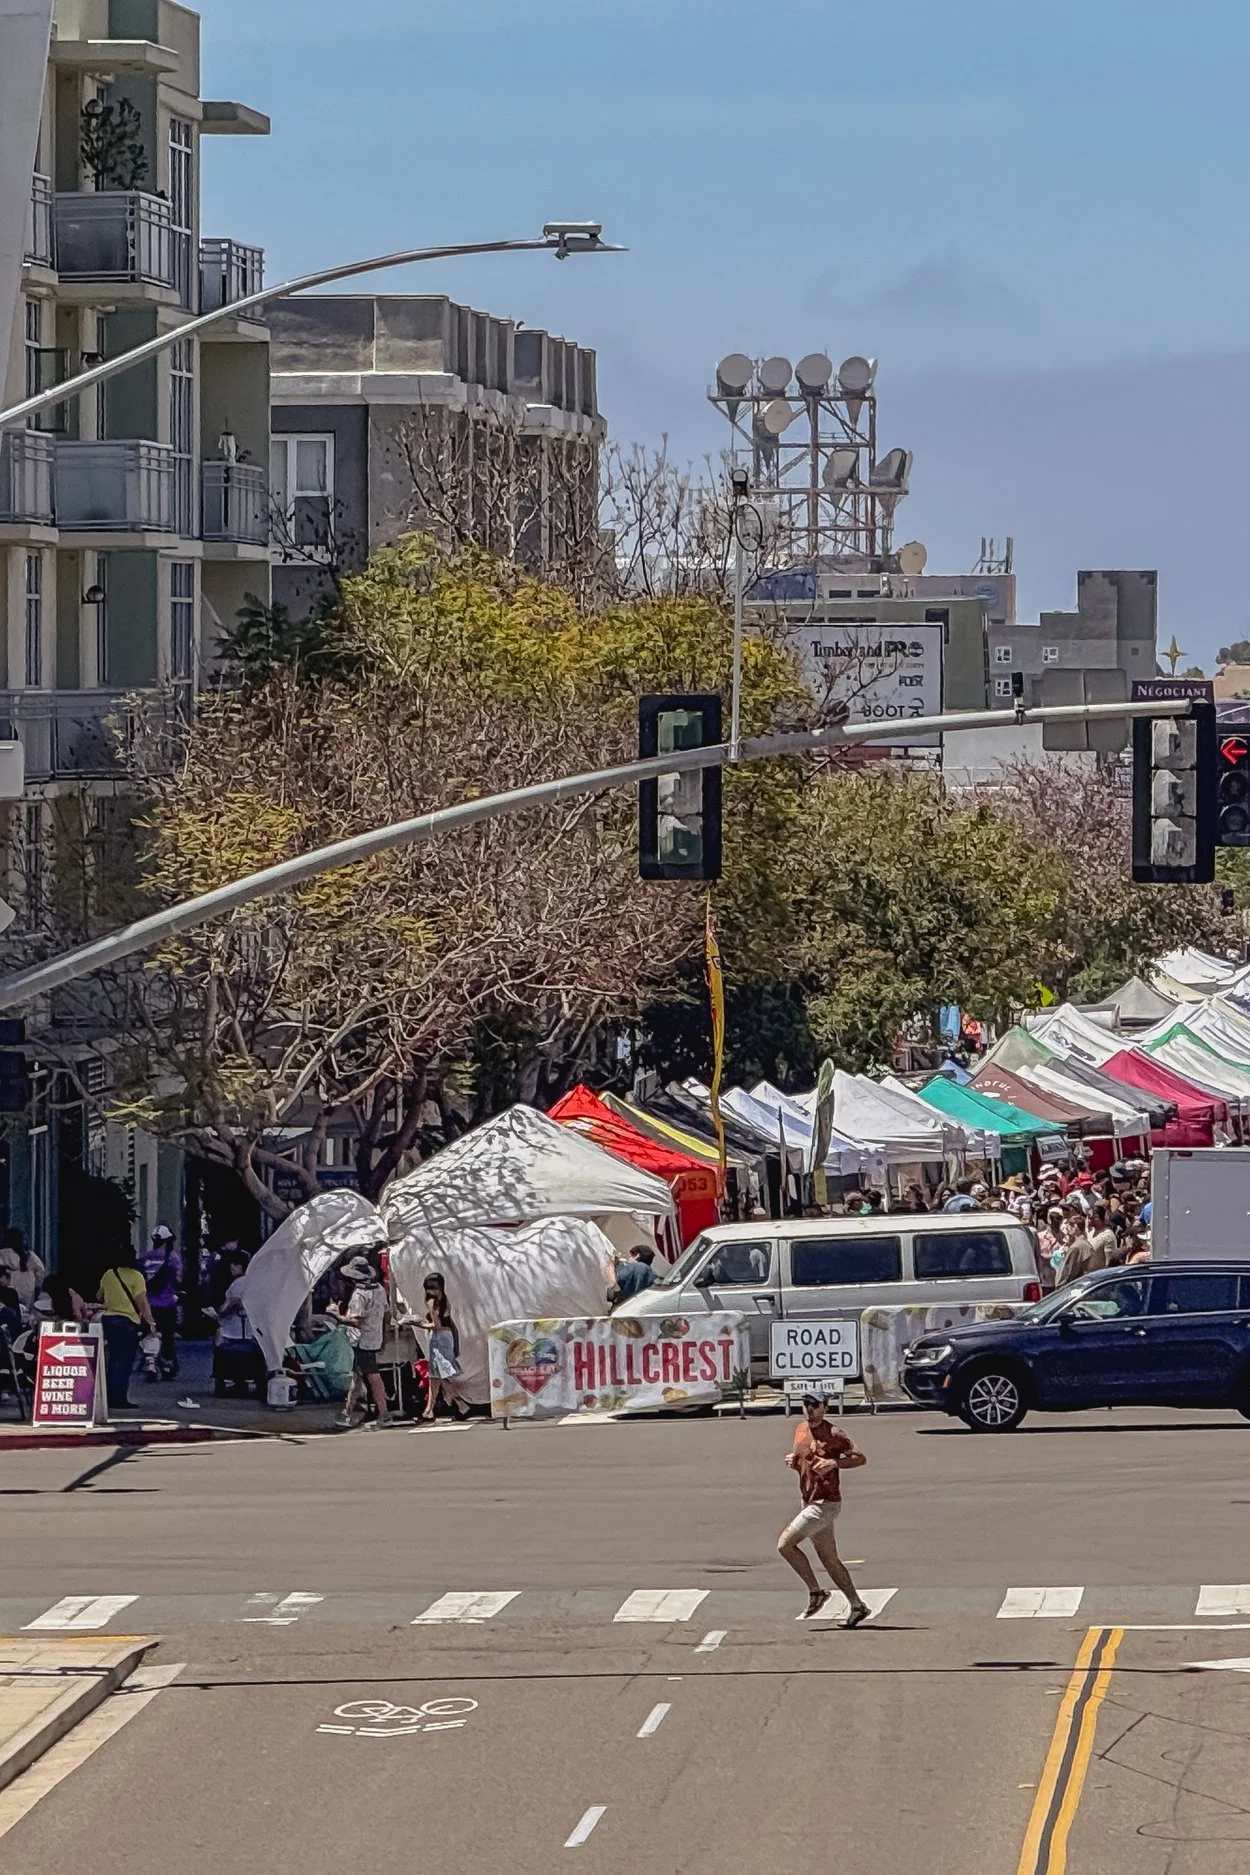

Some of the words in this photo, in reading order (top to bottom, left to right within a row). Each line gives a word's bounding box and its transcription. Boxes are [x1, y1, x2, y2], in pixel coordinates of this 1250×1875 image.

[786, 1328, 842, 1346] ROAD
[573, 1339, 735, 1391] HILLCREST
[775, 1351, 854, 1369] CLOSED
[42, 1365, 88, 1377] LIQUOR
[41, 1378, 75, 1389] BEER
[41, 1391, 74, 1402] WINE
[51, 1403, 87, 1415] MORE
